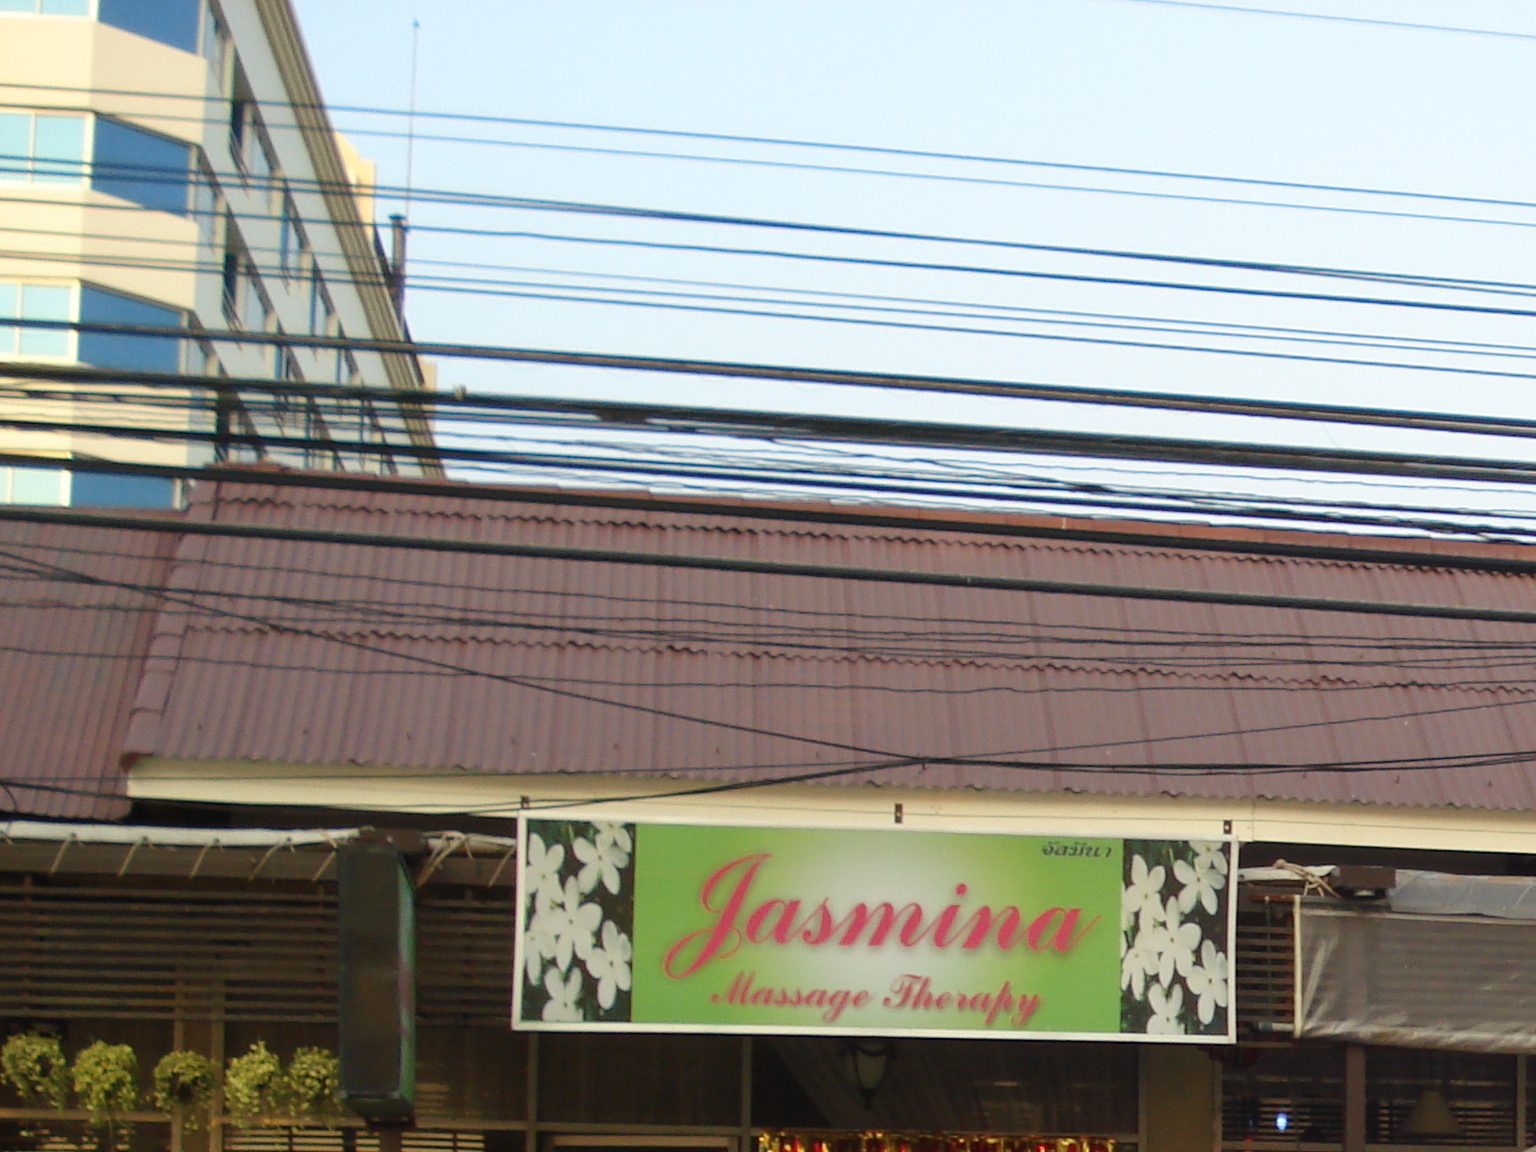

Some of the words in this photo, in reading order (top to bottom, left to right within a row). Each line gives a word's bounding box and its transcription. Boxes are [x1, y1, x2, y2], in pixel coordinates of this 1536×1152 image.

[663, 853, 1103, 979] Jasmina
[710, 971, 870, 1023] Massage
[883, 974, 1044, 1027] Therapy
